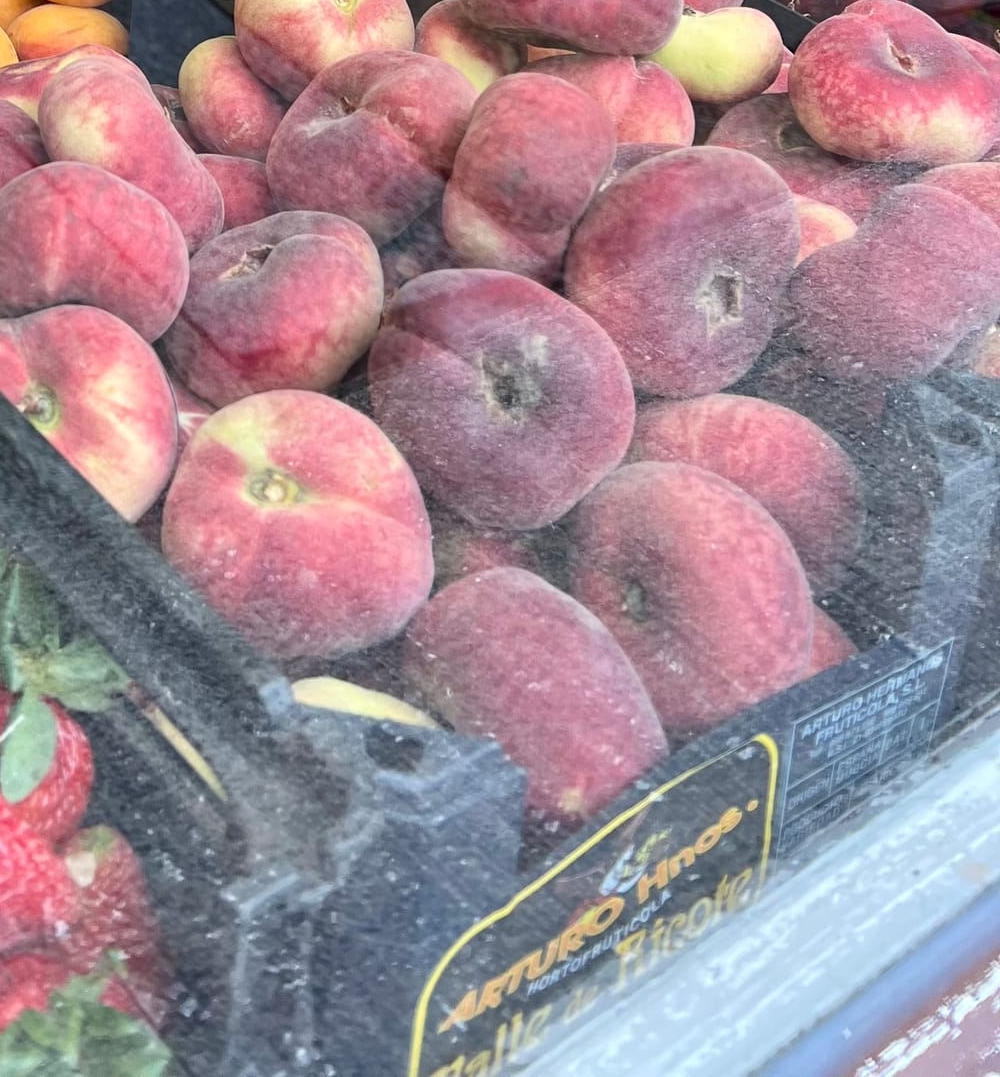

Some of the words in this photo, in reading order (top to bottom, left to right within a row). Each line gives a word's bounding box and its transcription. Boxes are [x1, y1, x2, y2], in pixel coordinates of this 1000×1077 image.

[801, 696, 864, 740] ARTURO
[437, 896, 625, 1035] ARTURO
[527, 889, 672, 997] HORTOFRUTICOLA
